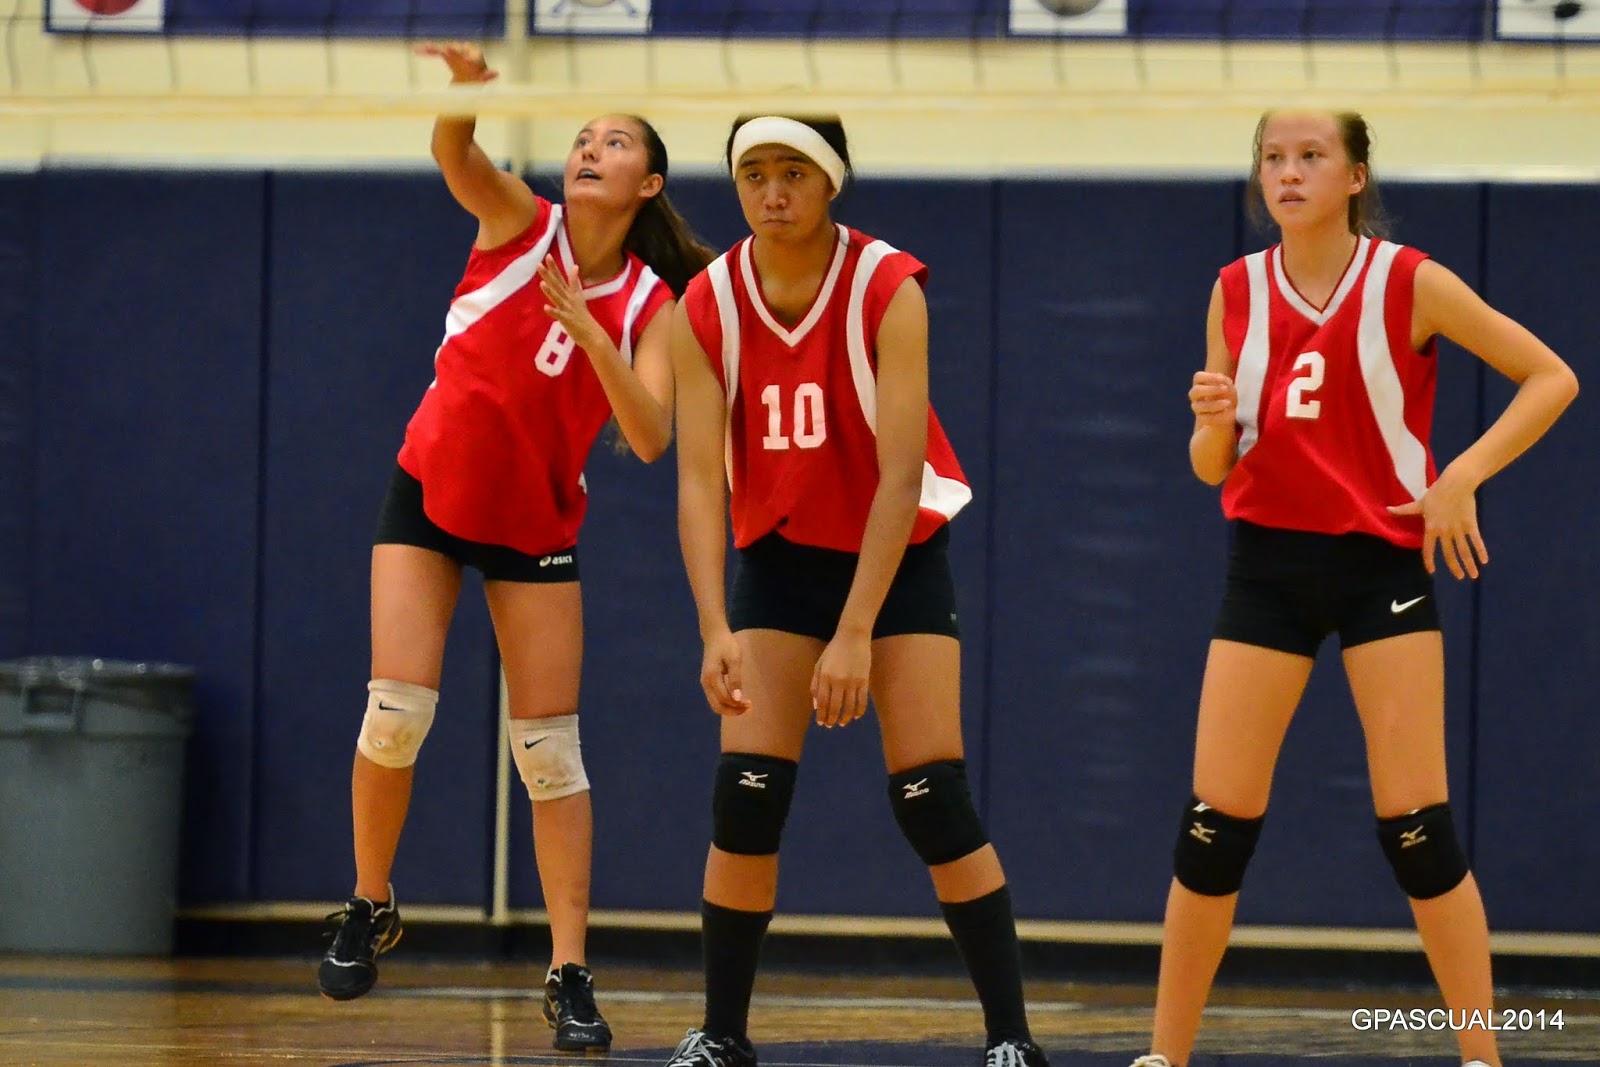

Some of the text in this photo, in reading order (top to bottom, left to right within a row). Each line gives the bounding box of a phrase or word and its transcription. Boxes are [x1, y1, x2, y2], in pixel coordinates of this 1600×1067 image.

[533, 319, 576, 377] 8
[761, 382, 827, 449] 10
[1286, 350, 1326, 419] 2
